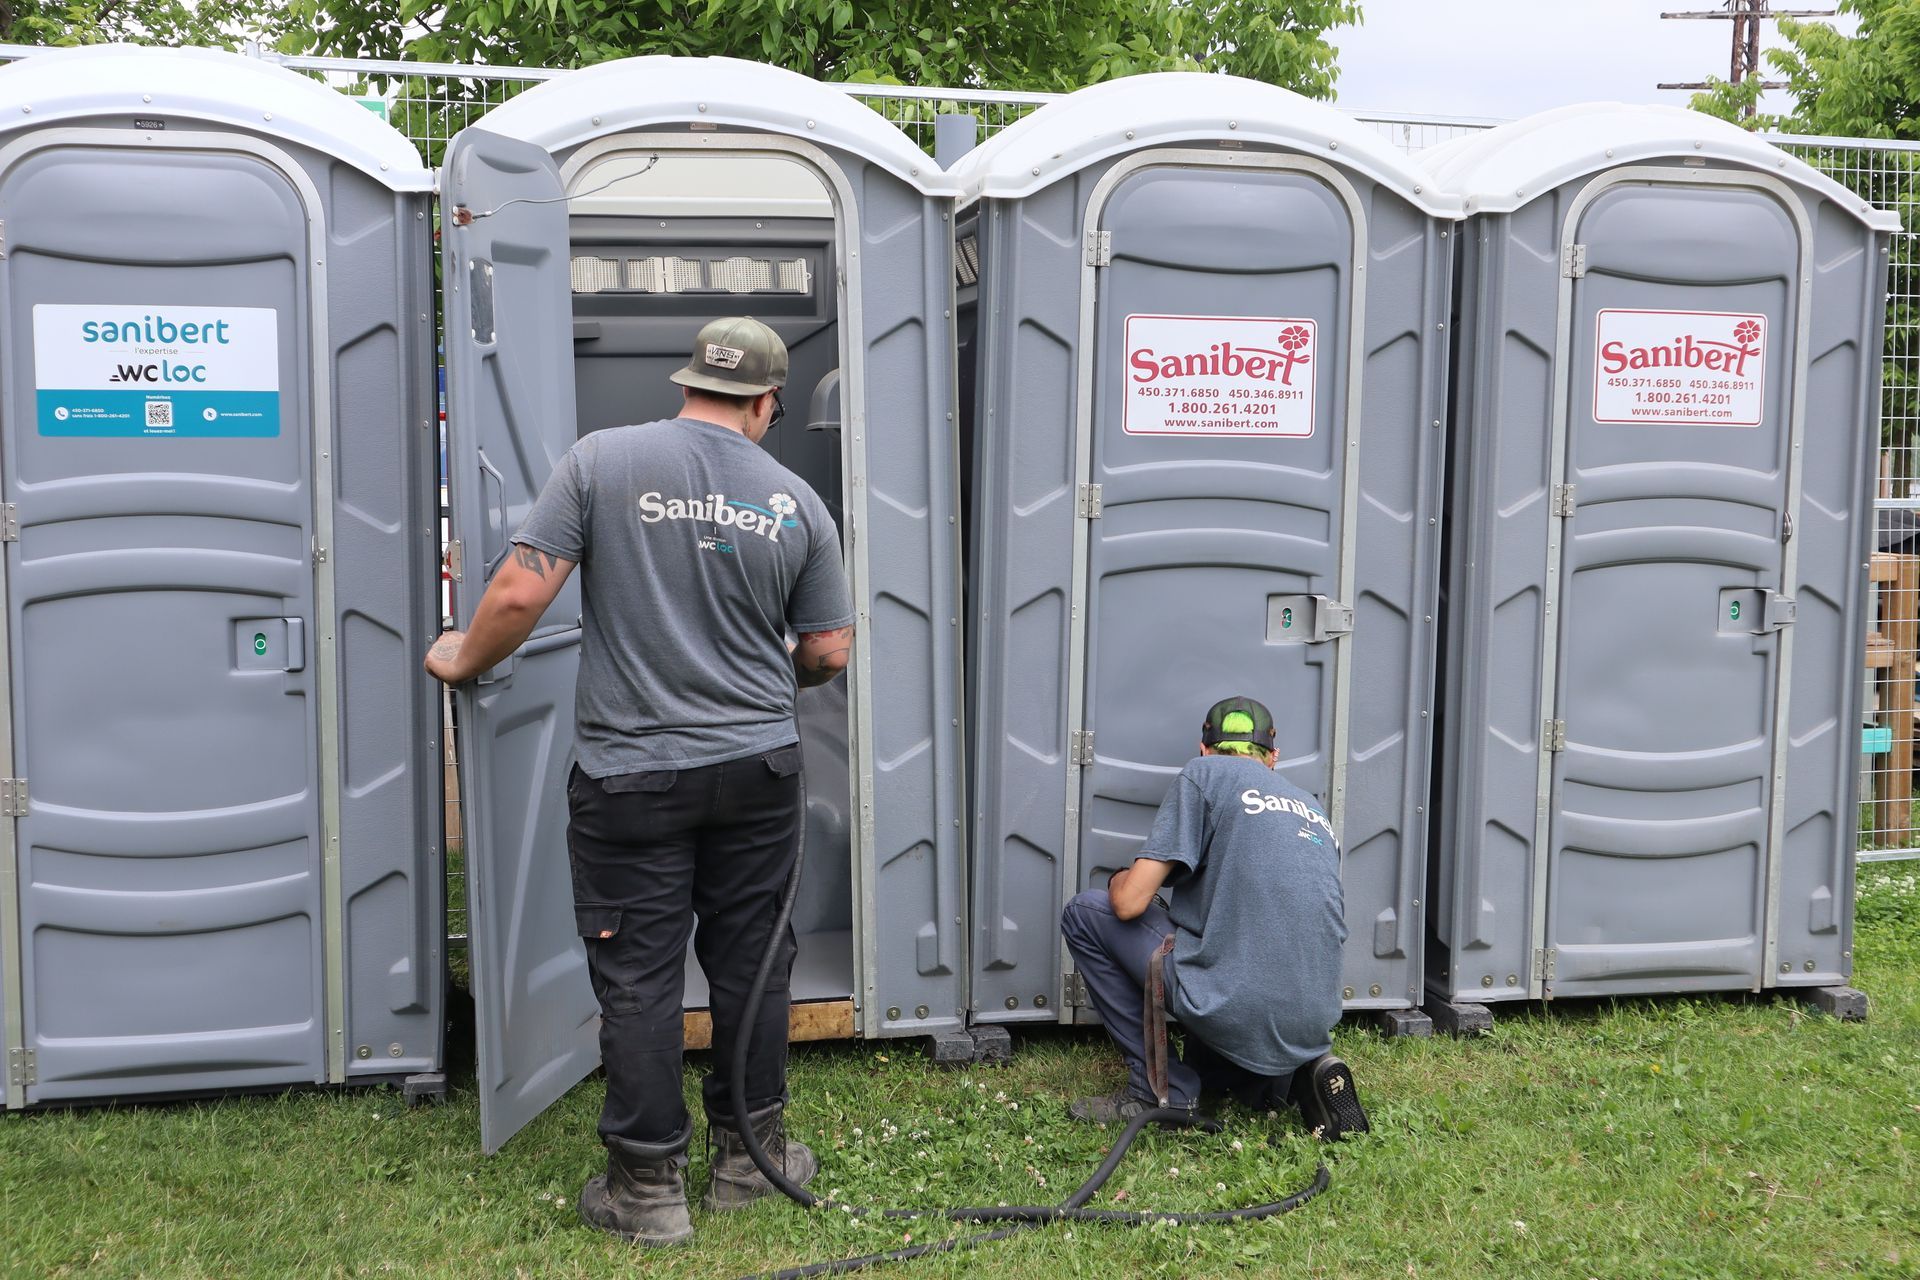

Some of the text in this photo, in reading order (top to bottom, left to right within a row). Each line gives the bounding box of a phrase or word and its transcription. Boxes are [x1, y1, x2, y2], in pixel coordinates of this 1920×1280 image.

[82, 315, 229, 344] sanibert
[134, 347, 178, 355] l'expertise
[711, 346, 736, 359] VANS
[1602, 335, 1760, 377] Sanibert
[1130, 342, 1310, 386] Sanibert
[1607, 378, 1754, 390] 450.371.6850 450.346.8911
[1138, 387, 1304, 399] 450.371.6850 450.346.8911
[1635, 392, 1731, 405] 1.800.261.4201
[1168, 402, 1276, 414] 1.800.261.4201
[1631, 408, 1733, 418] www.sanibert.com
[1164, 418, 1279, 428] www.sanibert.com
[638, 491, 794, 543] Sanibert
